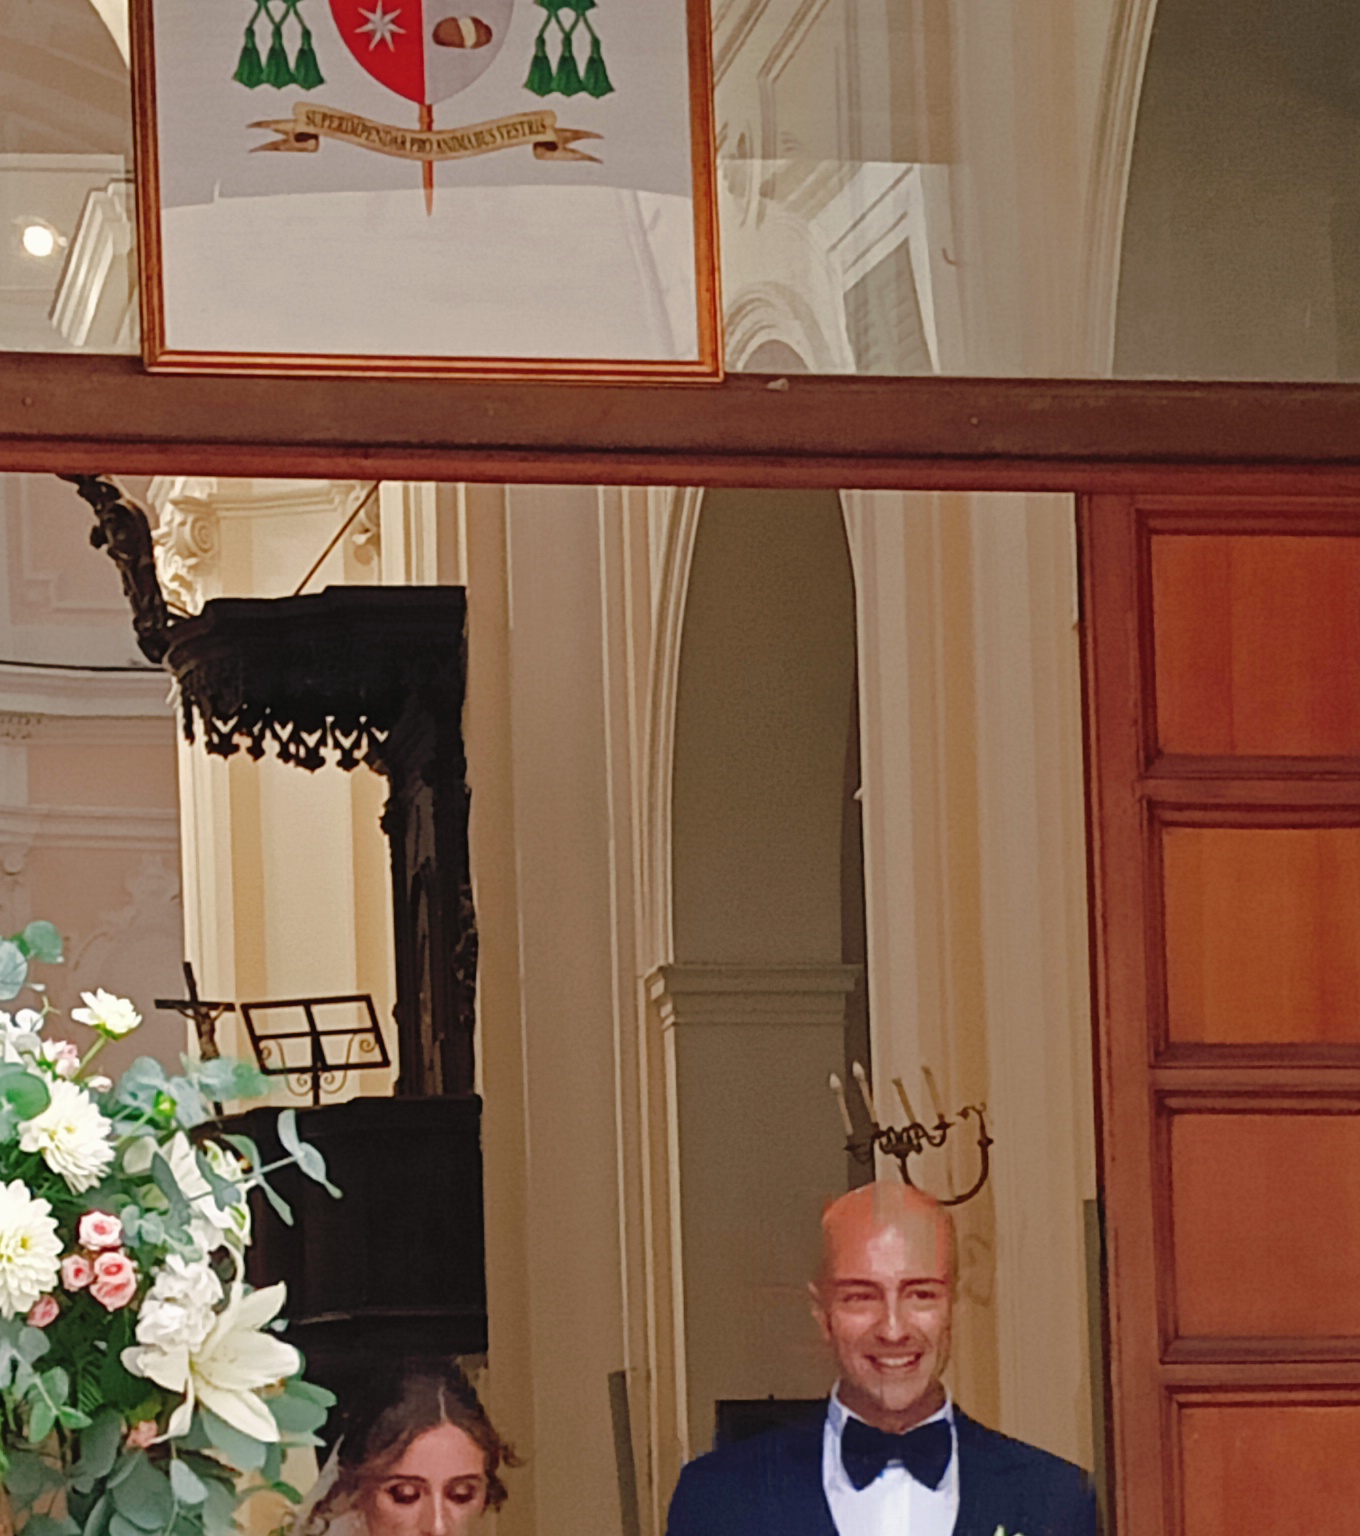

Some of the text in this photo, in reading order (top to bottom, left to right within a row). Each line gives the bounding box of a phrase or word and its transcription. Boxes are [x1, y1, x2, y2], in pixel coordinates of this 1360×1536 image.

[409, 136, 433, 153] PRO
[436, 127, 497, 153] ANIMABUS
[496, 117, 547, 141] VESTRIS
